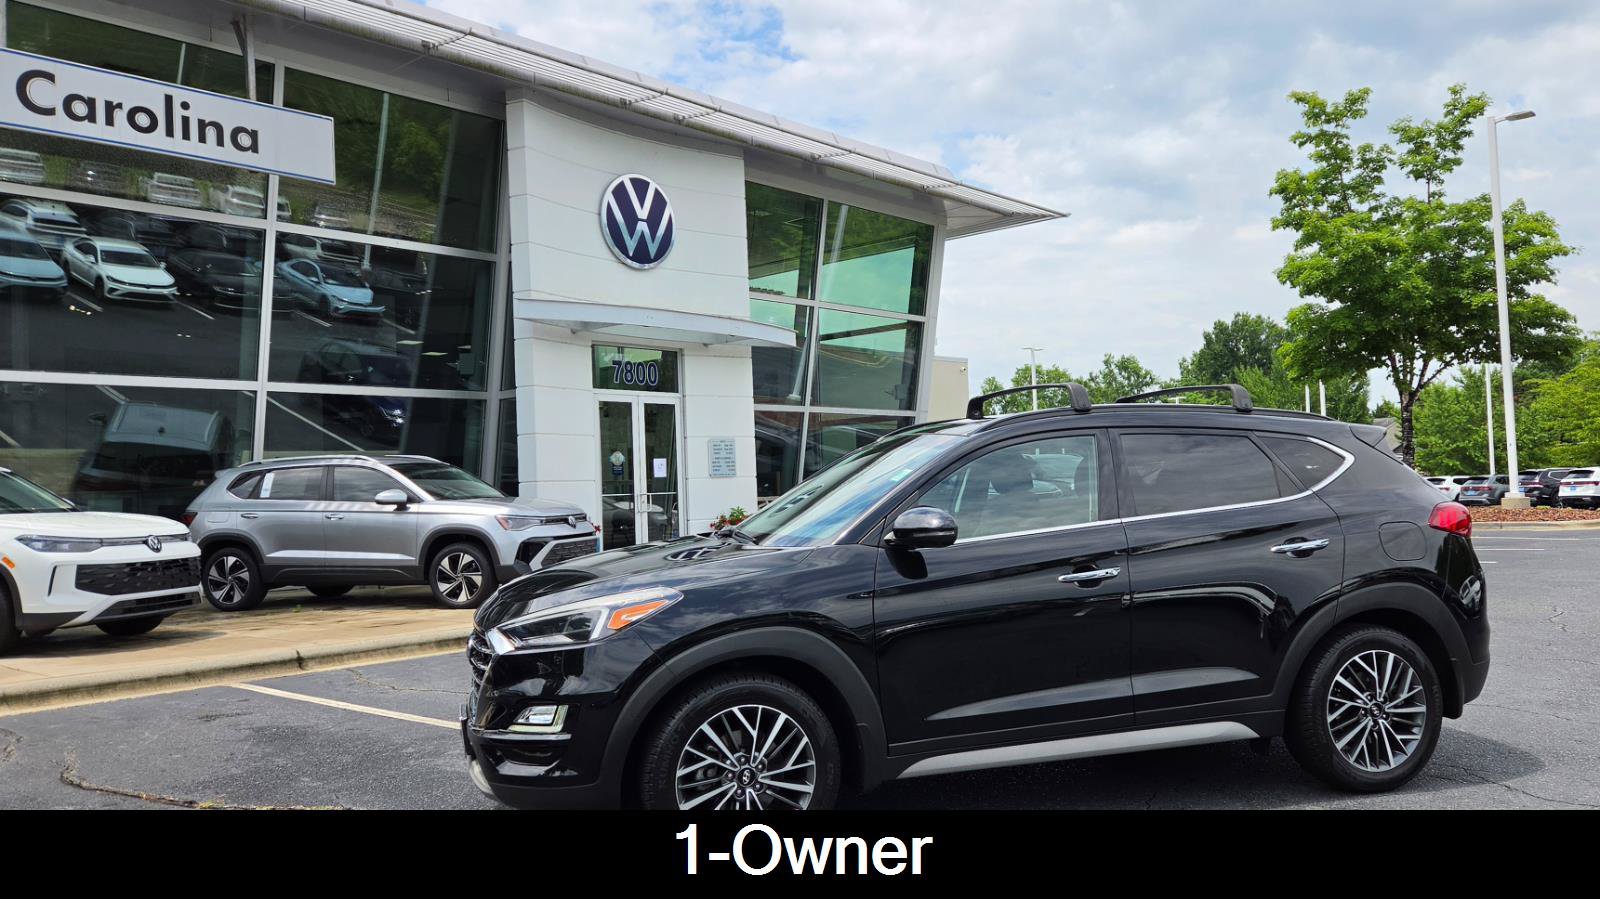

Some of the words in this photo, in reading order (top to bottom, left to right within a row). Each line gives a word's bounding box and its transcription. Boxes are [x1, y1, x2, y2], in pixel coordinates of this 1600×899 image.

[15, 69, 260, 154] Carolina
[602, 174, 674, 265] VW
[612, 360, 659, 386] 7800
